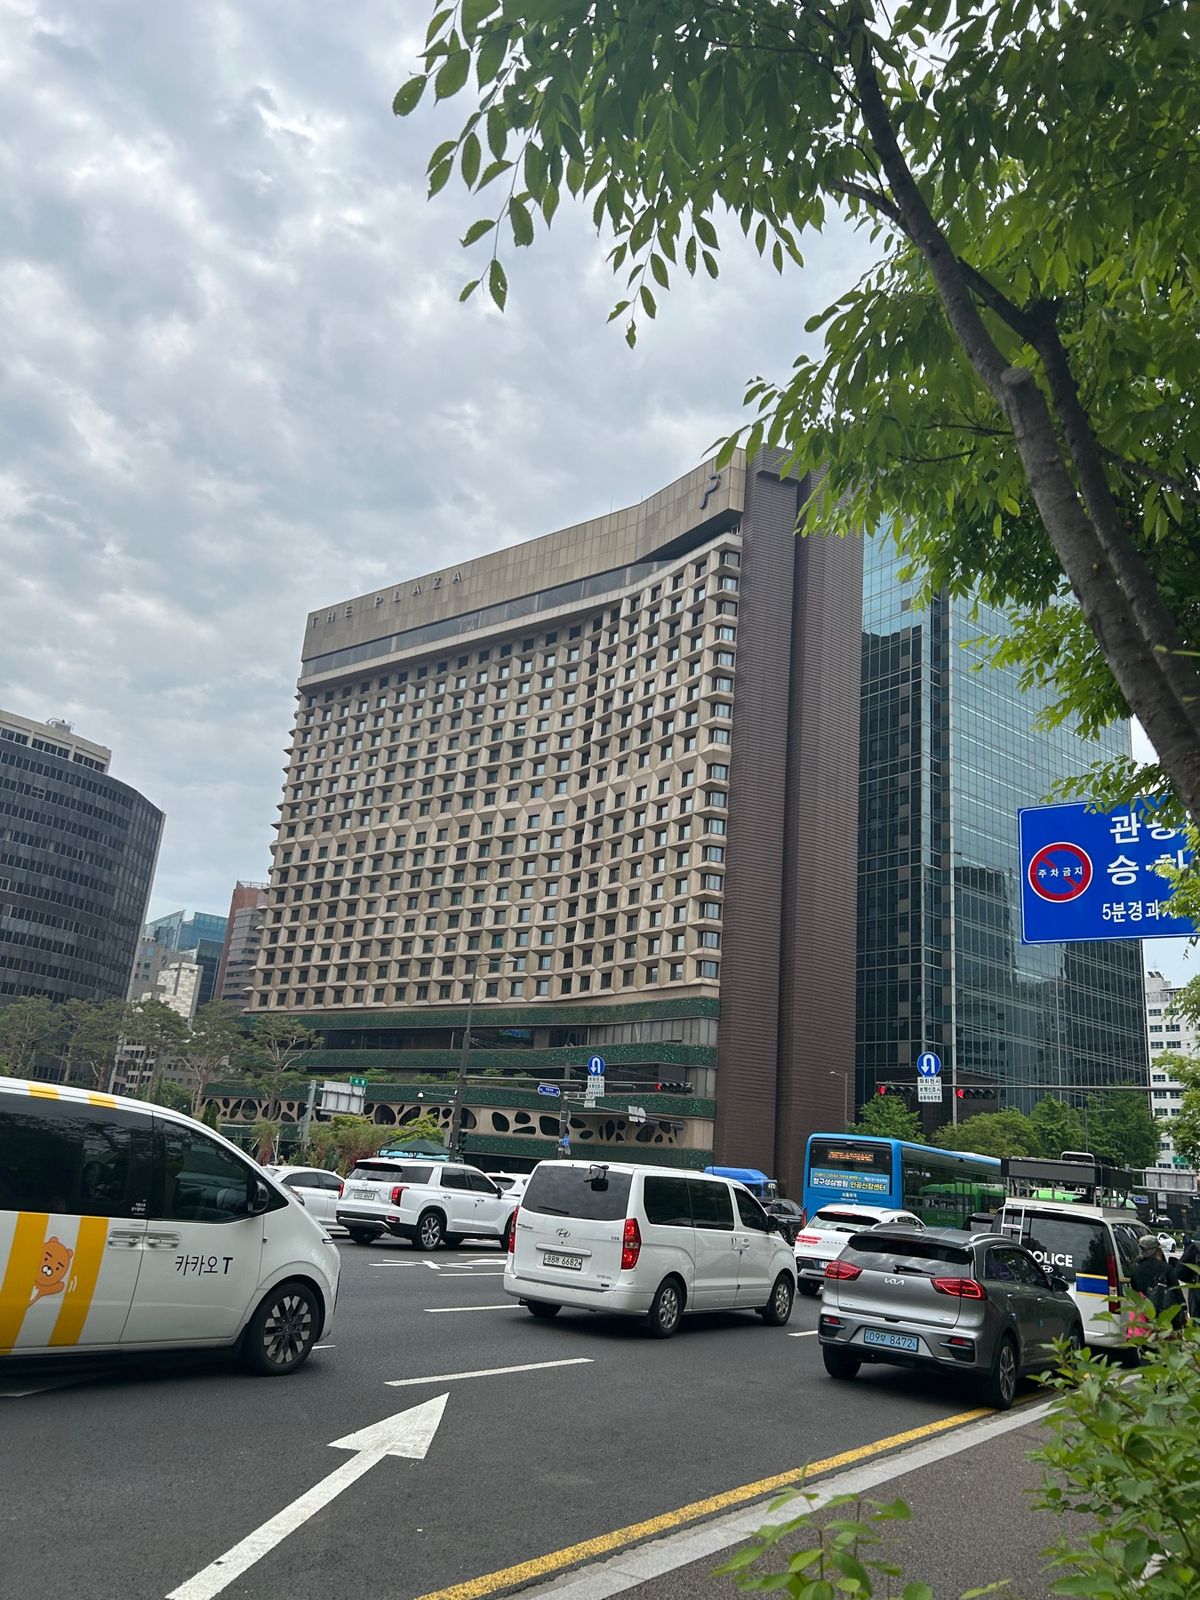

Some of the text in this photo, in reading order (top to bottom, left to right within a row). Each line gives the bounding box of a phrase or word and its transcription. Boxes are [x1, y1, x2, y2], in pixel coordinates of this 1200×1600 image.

[312, 571, 463, 628] THE PLAZA
[175, 1254, 233, 1276] 카카오 T
[561, 1257, 579, 1268] 6682
[884, 1277, 905, 1286] KIA
[889, 1335, 914, 1348] 8472
